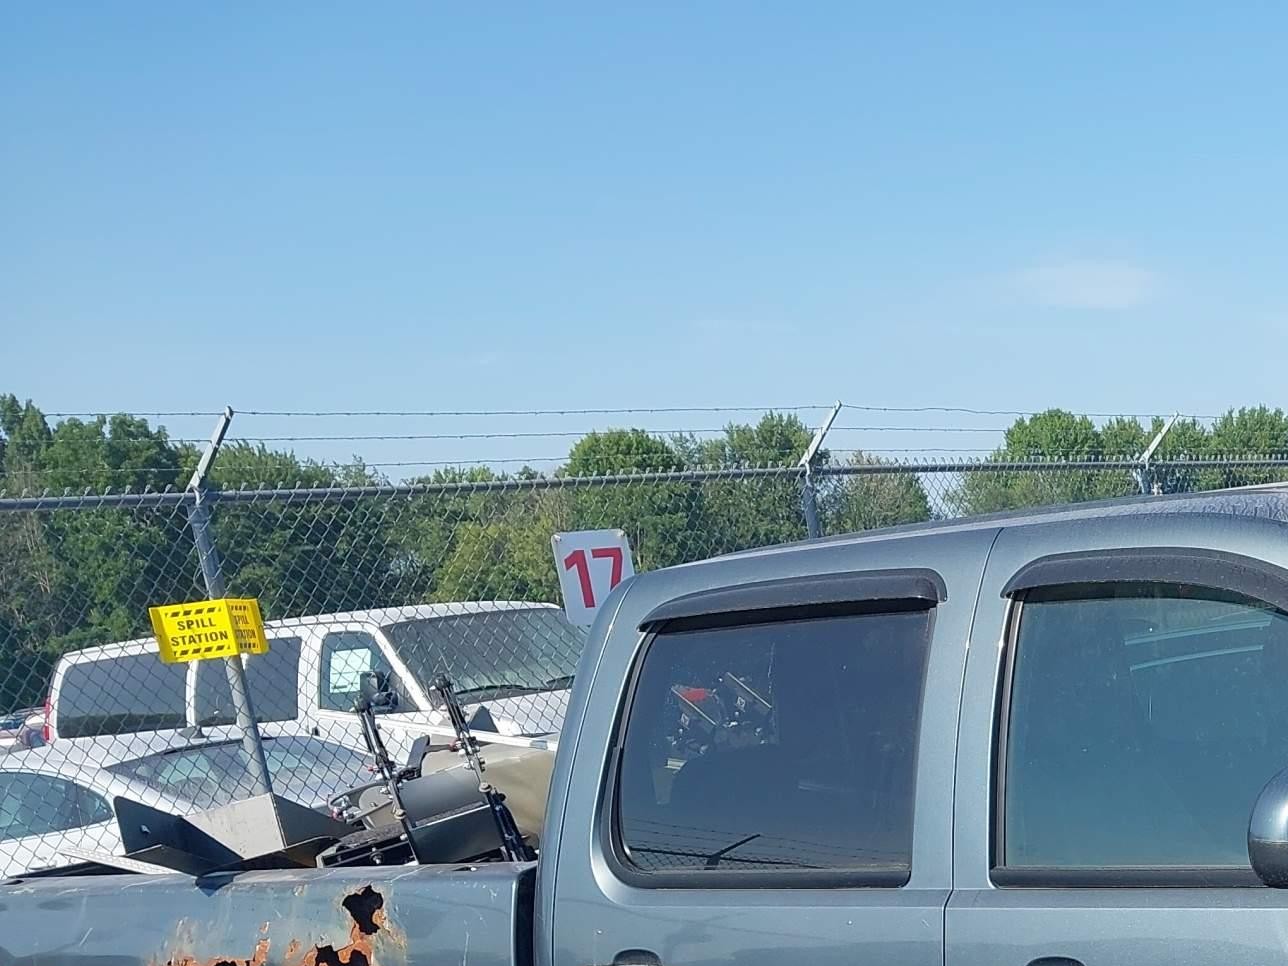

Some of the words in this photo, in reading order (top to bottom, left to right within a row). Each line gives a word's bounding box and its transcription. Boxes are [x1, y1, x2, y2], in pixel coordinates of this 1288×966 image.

[564, 547, 623, 608] 17
[177, 617, 216, 631] SPILL
[171, 630, 229, 647] STATION
